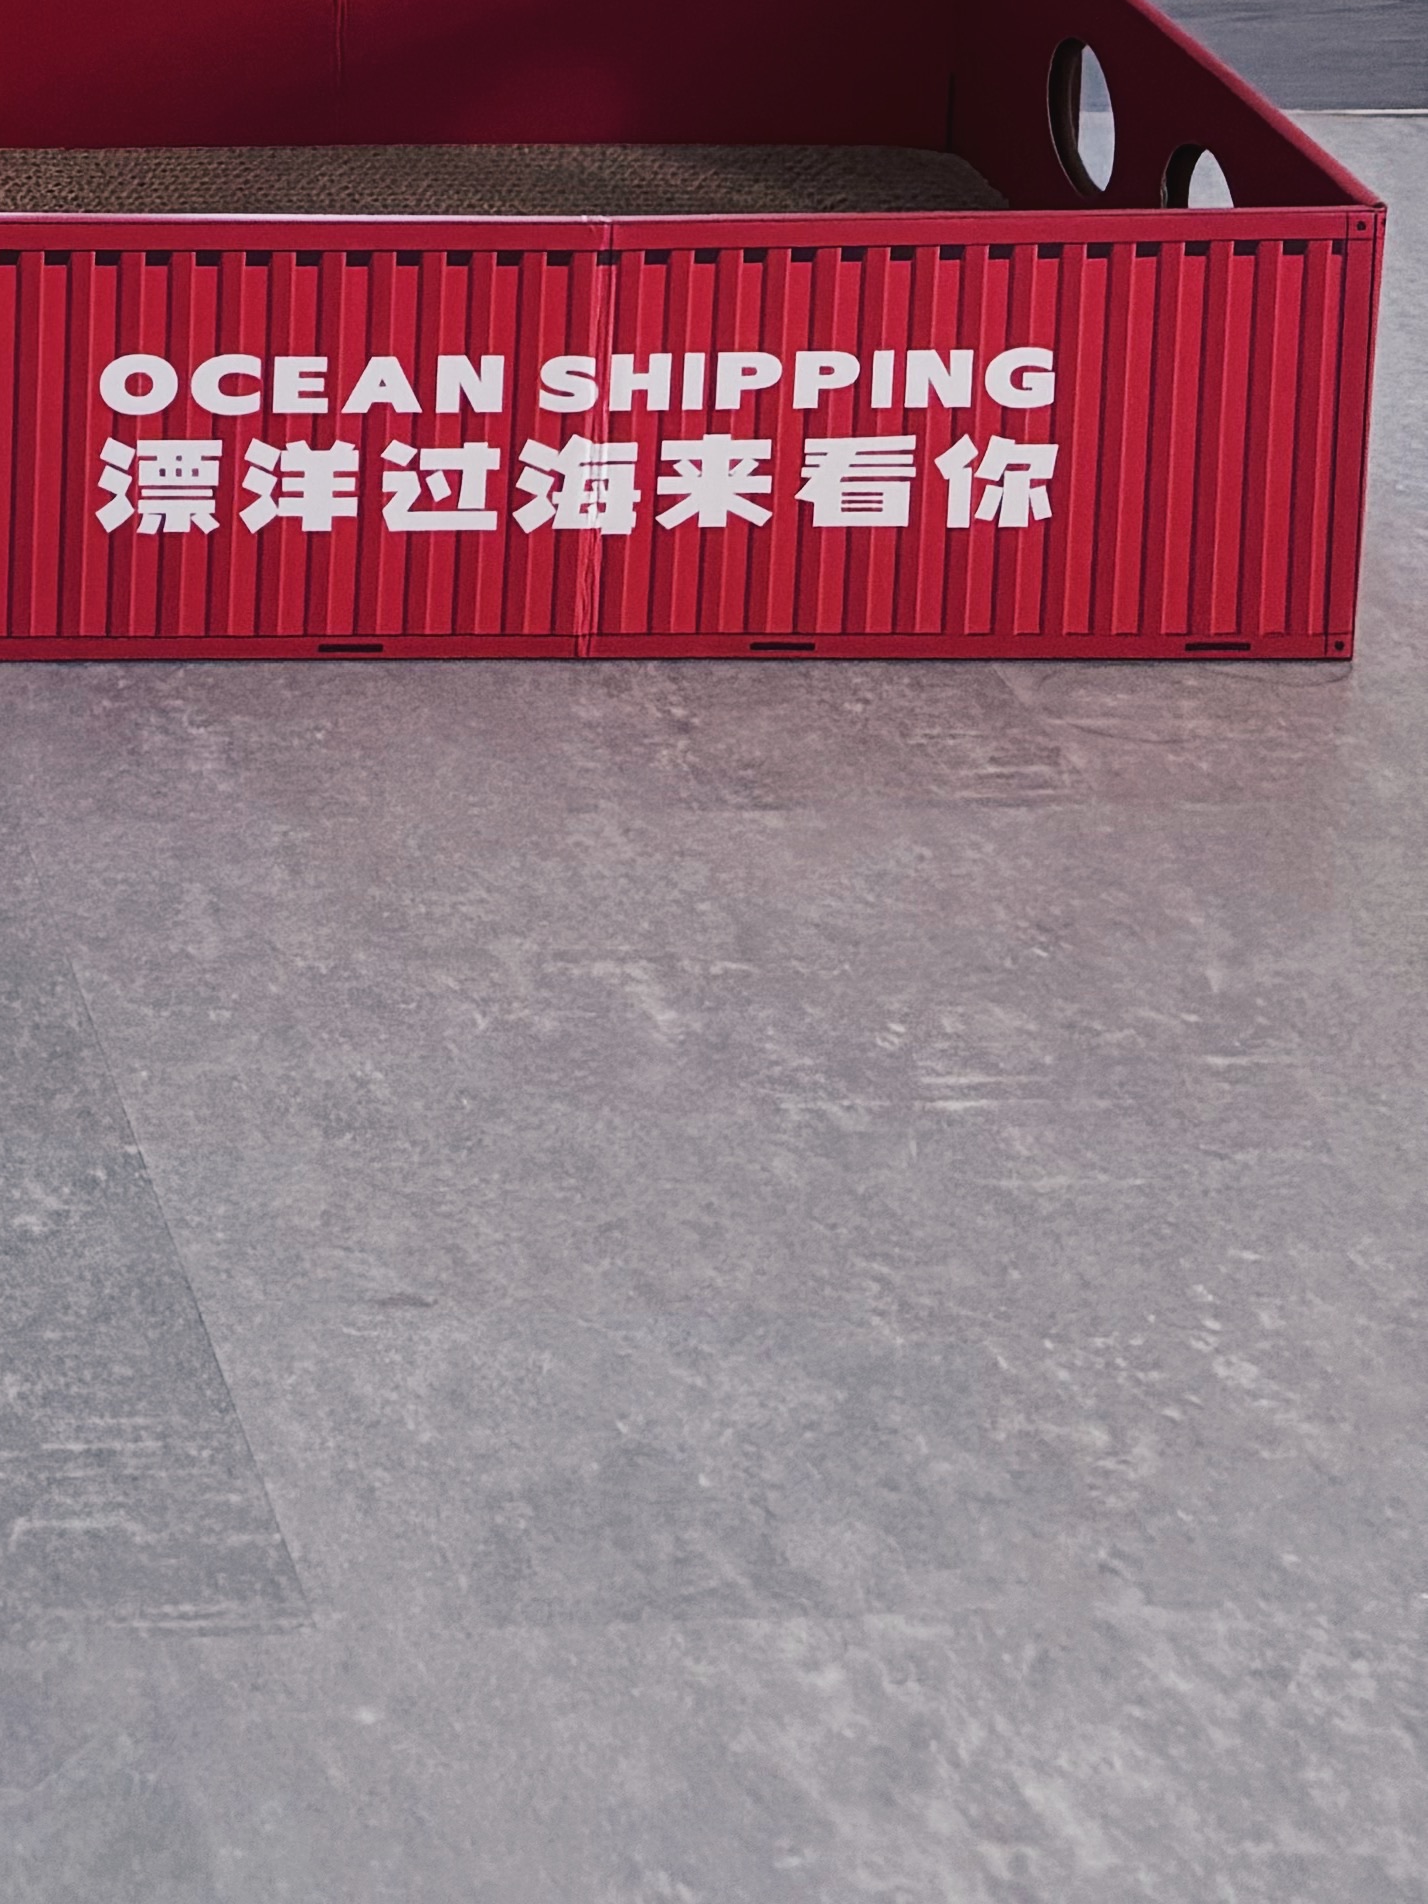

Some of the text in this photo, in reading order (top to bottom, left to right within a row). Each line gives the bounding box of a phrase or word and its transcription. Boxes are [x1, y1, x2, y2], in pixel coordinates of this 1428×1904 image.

[98, 345, 1058, 417] OCEAN SHIPPING
[94, 432, 1060, 537] 漂洋过海来看你
